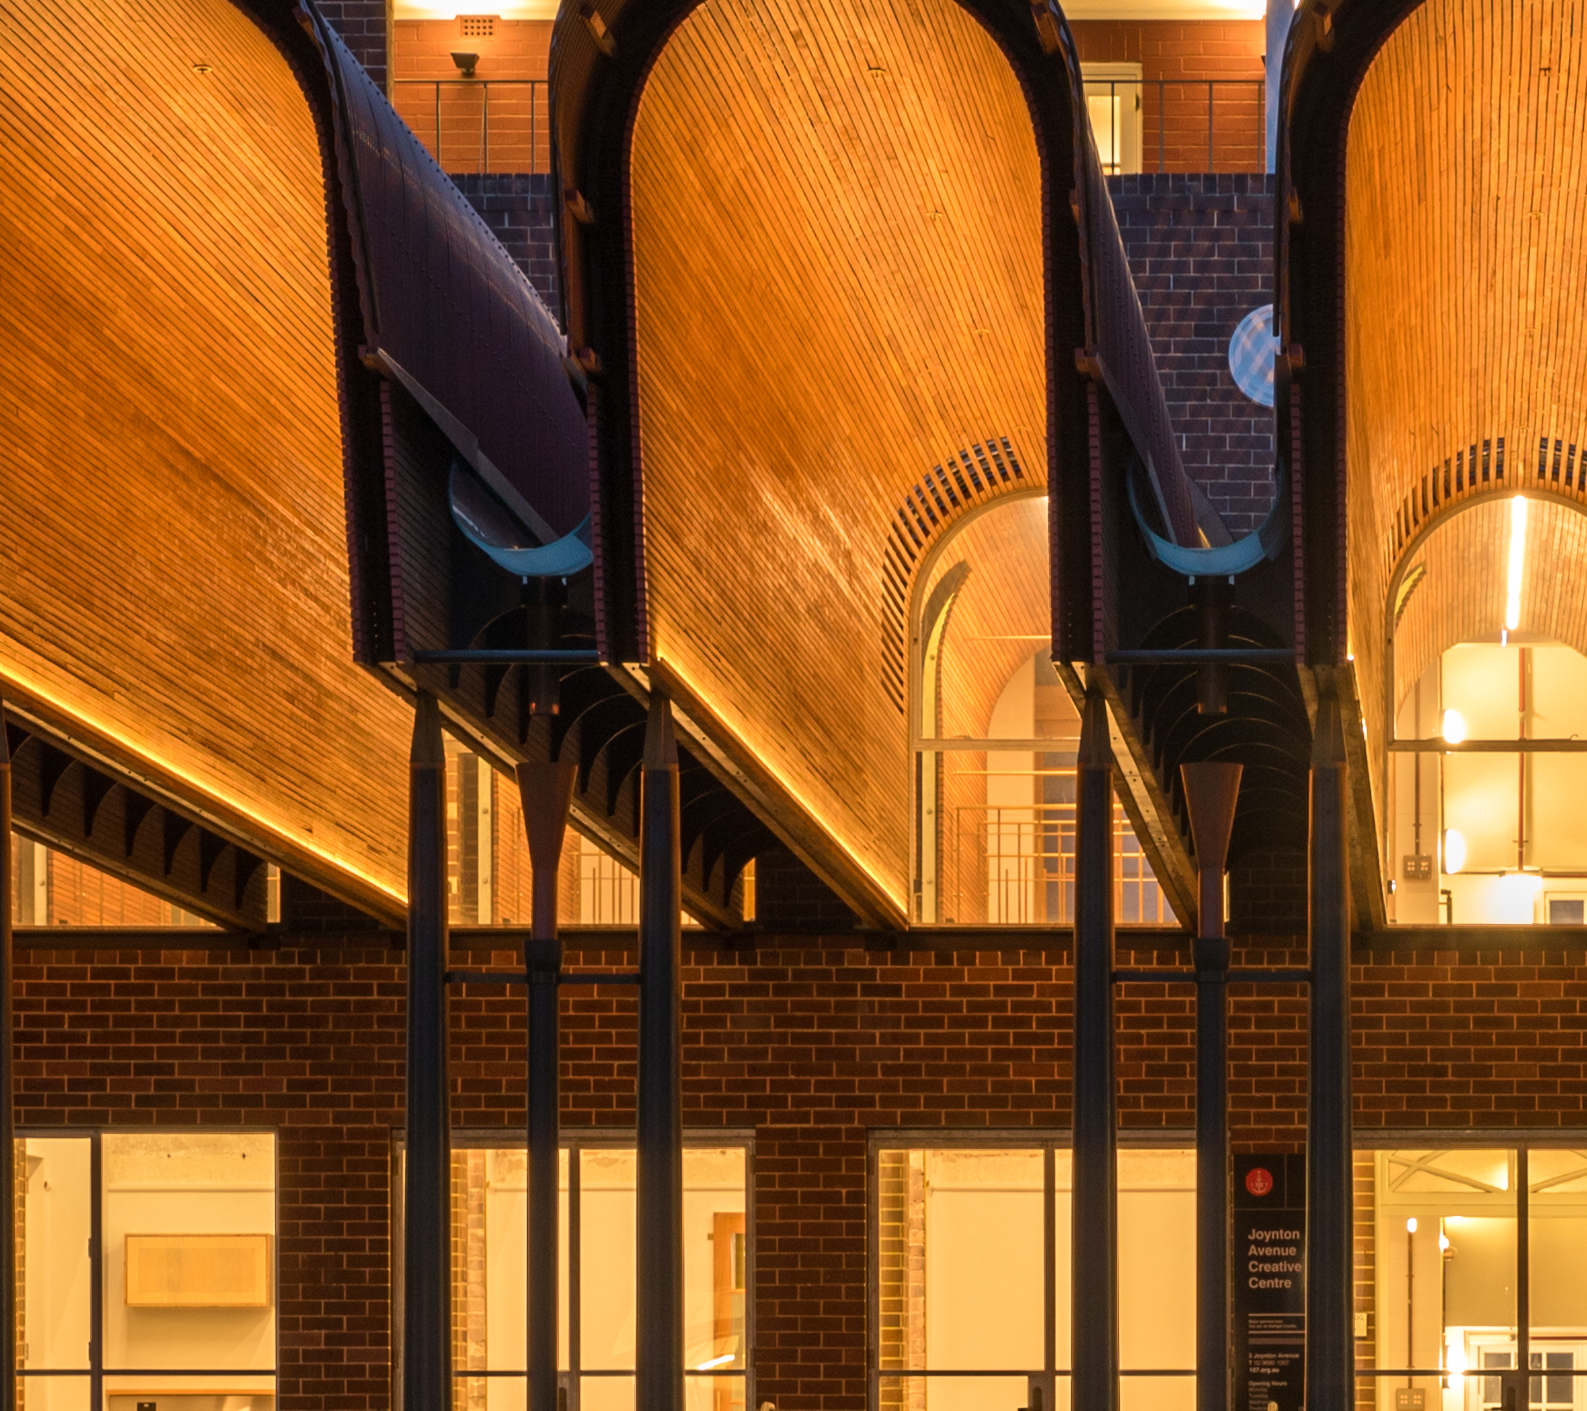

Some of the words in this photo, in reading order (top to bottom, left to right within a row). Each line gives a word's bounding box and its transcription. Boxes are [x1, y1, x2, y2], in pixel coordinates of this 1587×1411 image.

[1248, 1229, 1300, 1242] Joynton
[1248, 1244, 1297, 1256] Avenue
[1248, 1260, 1302, 1272] Creative
[1248, 1277, 1292, 1288] Centre
